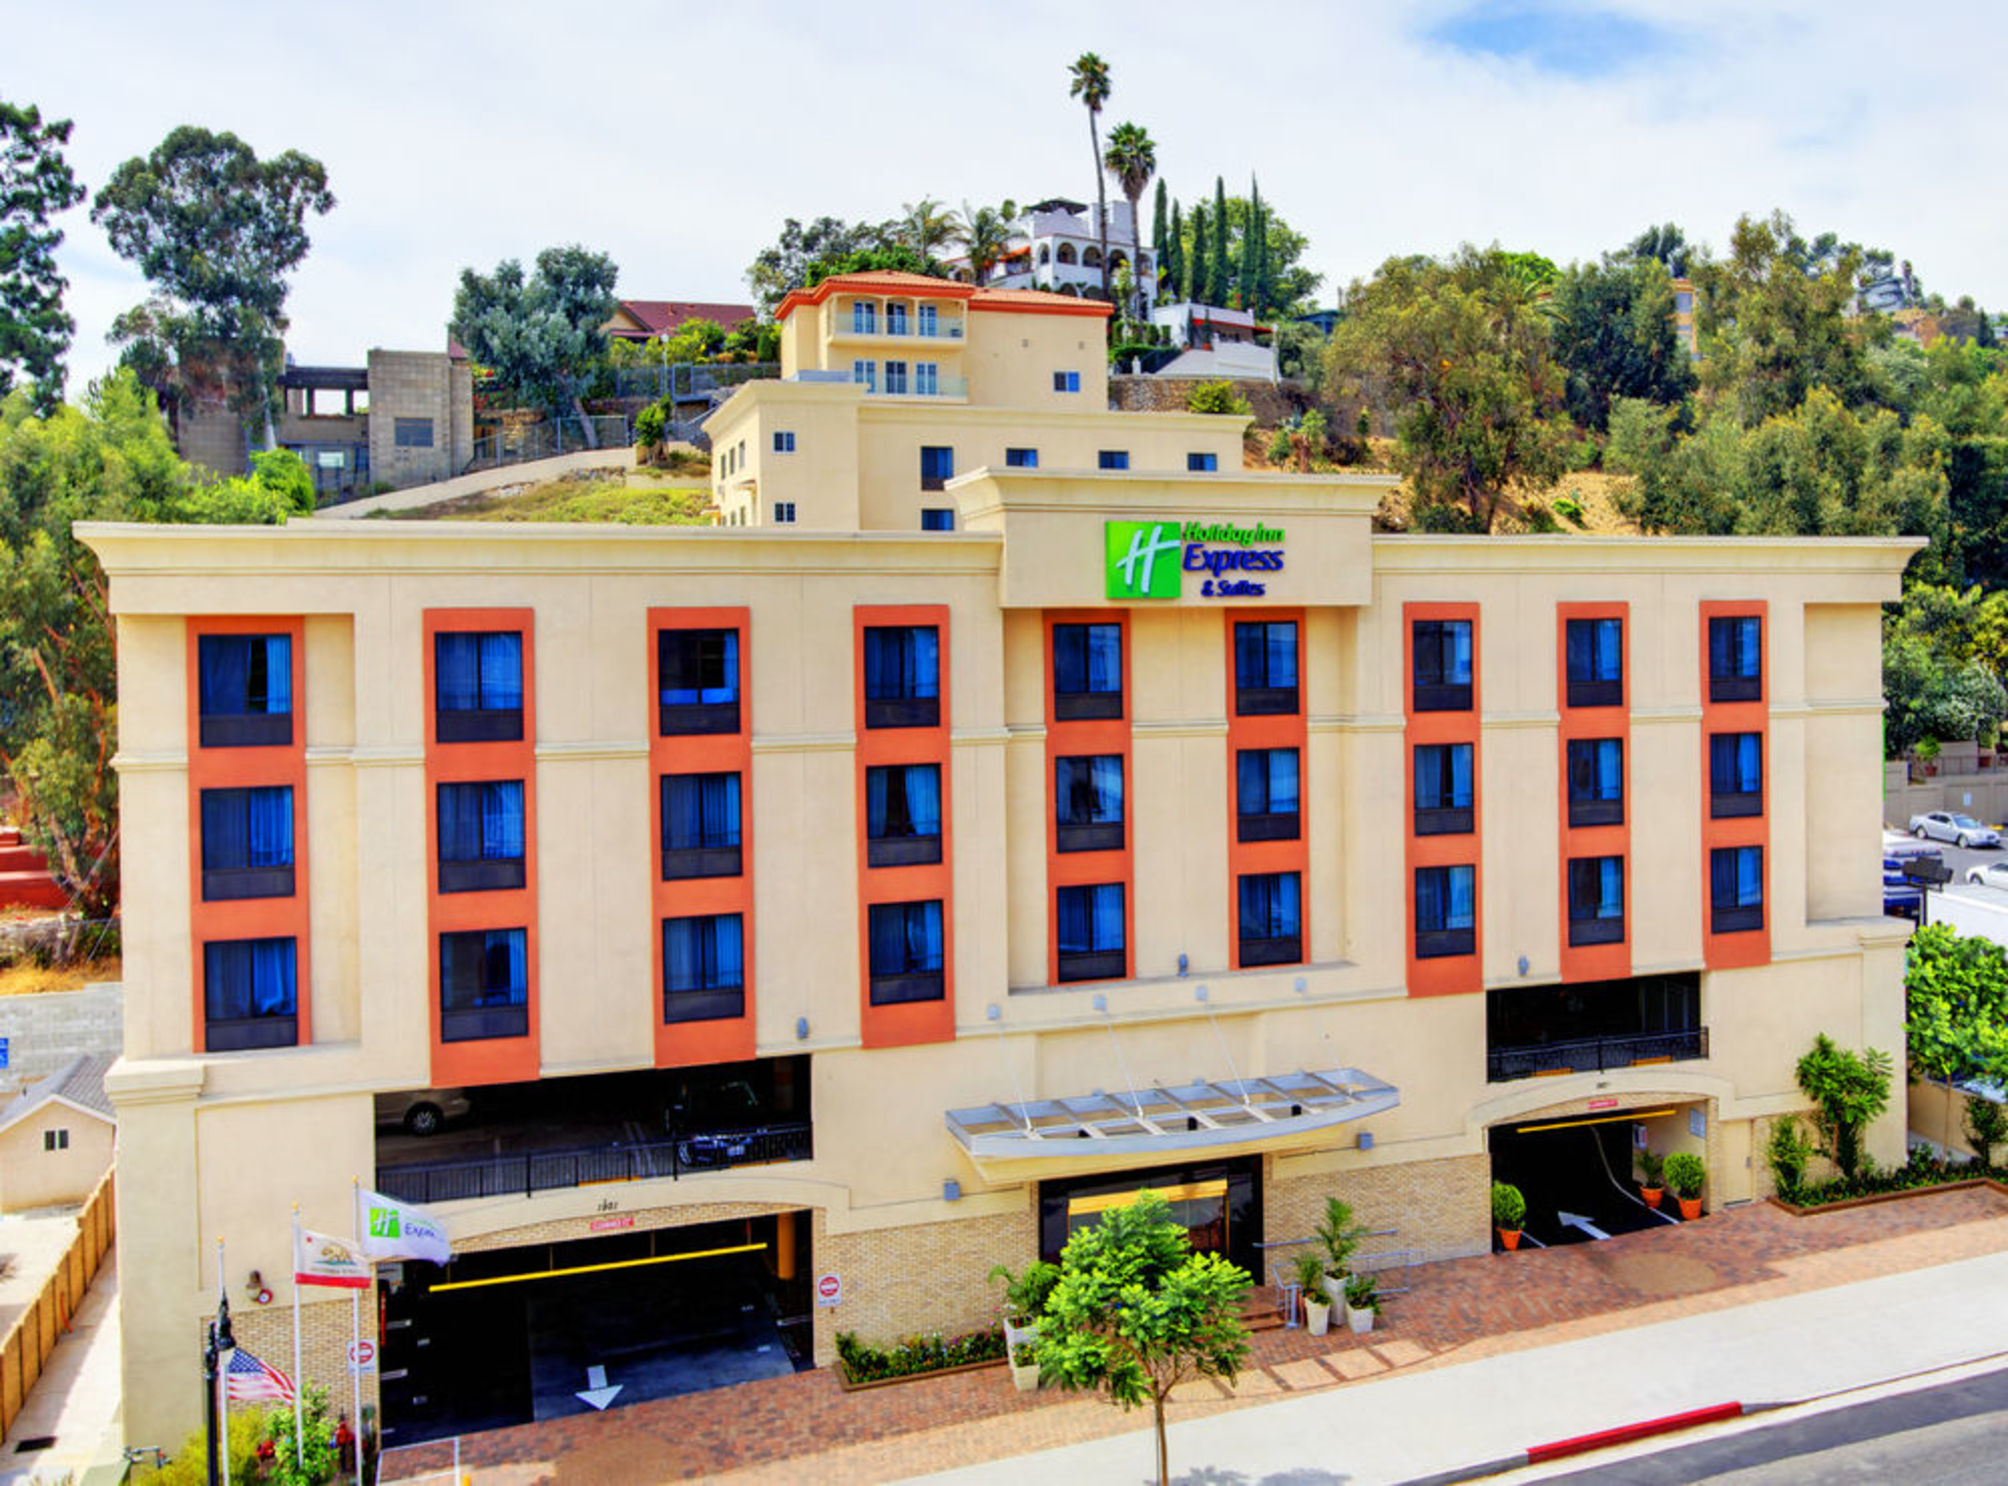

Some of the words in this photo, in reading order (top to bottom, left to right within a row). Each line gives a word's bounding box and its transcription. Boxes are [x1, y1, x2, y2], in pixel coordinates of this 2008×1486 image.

[1183, 521, 1255, 546] Holiday
[1256, 522, 1285, 542] Inn
[1183, 544, 1285, 577] Express
[1201, 580, 1214, 597] &
[1217, 579, 1266, 597] Suites
